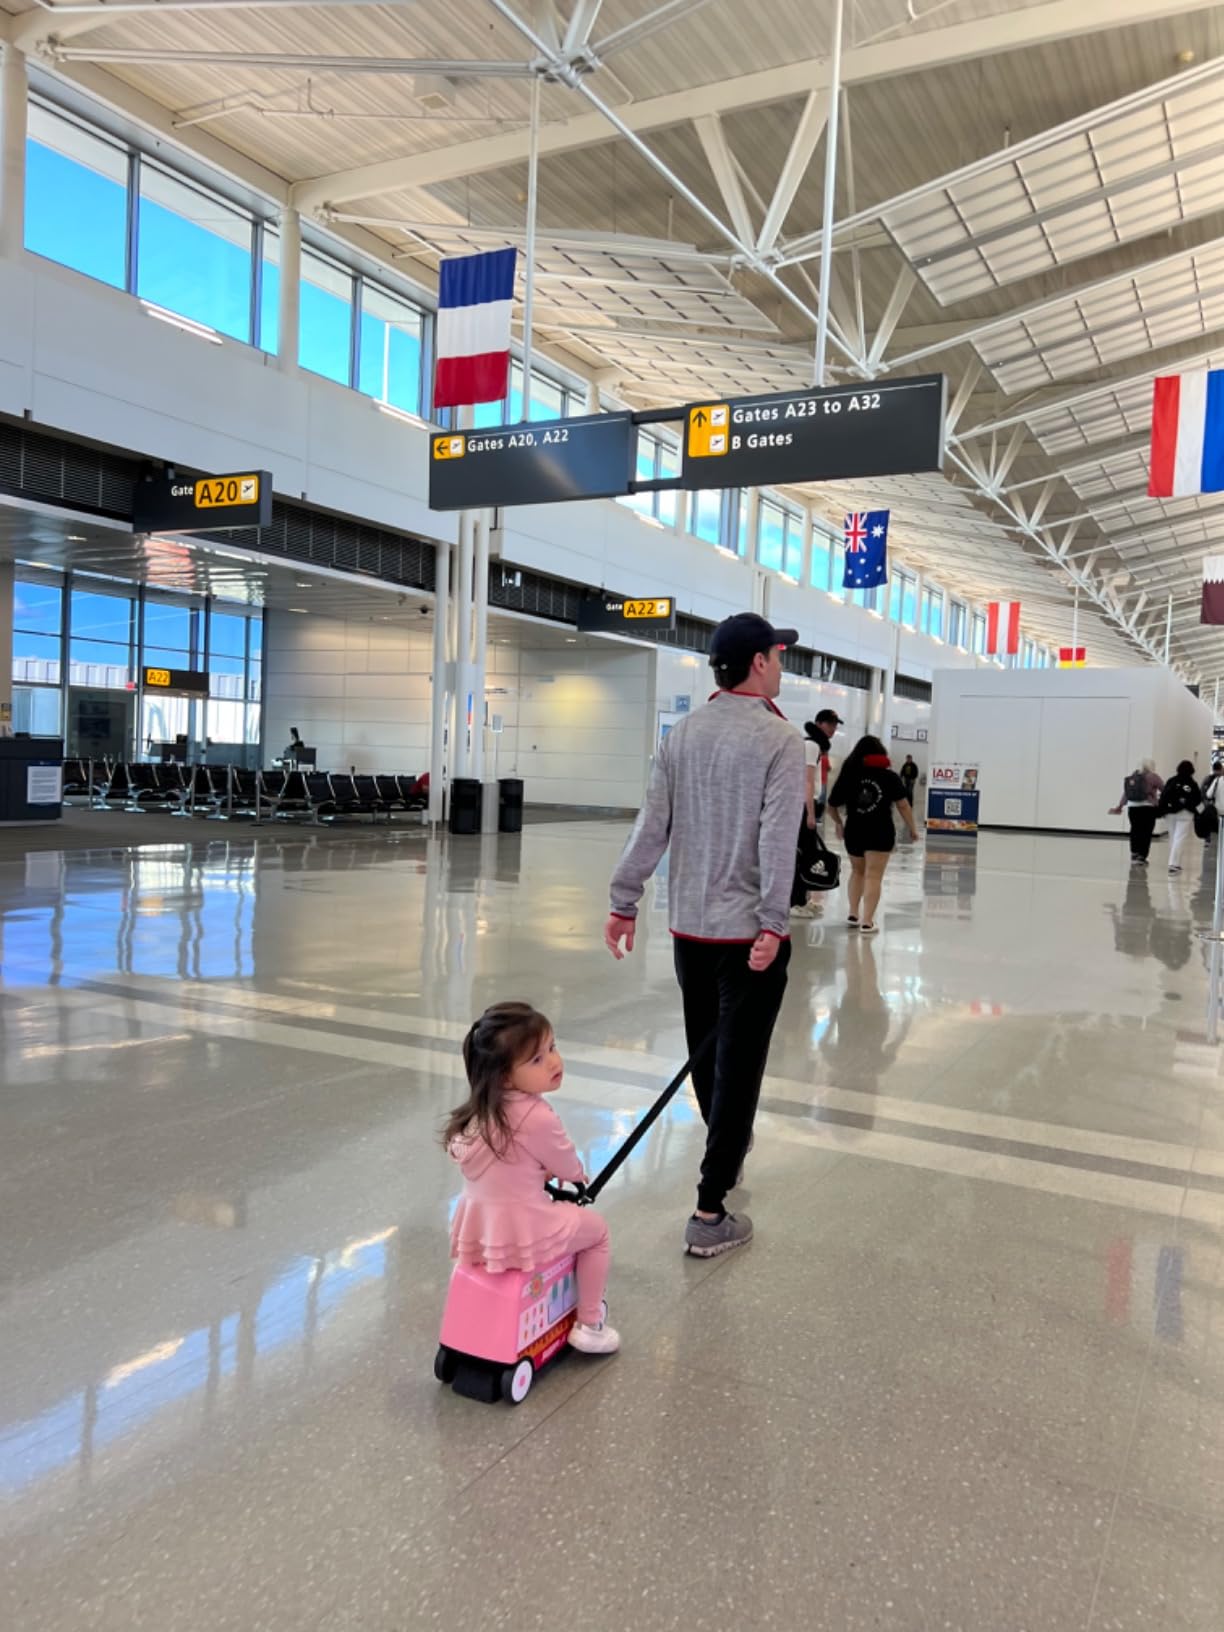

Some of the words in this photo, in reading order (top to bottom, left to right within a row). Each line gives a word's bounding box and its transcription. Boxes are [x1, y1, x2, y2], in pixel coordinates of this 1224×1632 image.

[733, 407, 779, 424] Gates
[785, 400, 816, 418] A23
[823, 401, 842, 414] to
[847, 393, 881, 411] A32
[467, 438, 504, 452] Gates
[508, 432, 538, 448] A20,
[542, 429, 569, 444] A22
[731, 435, 741, 450] B
[747, 432, 793, 449] Gates
[171, 485, 194, 497] Gate
[198, 480, 239, 504] A20
[605, 602, 623, 612] Gate
[626, 601, 656, 616] A22
